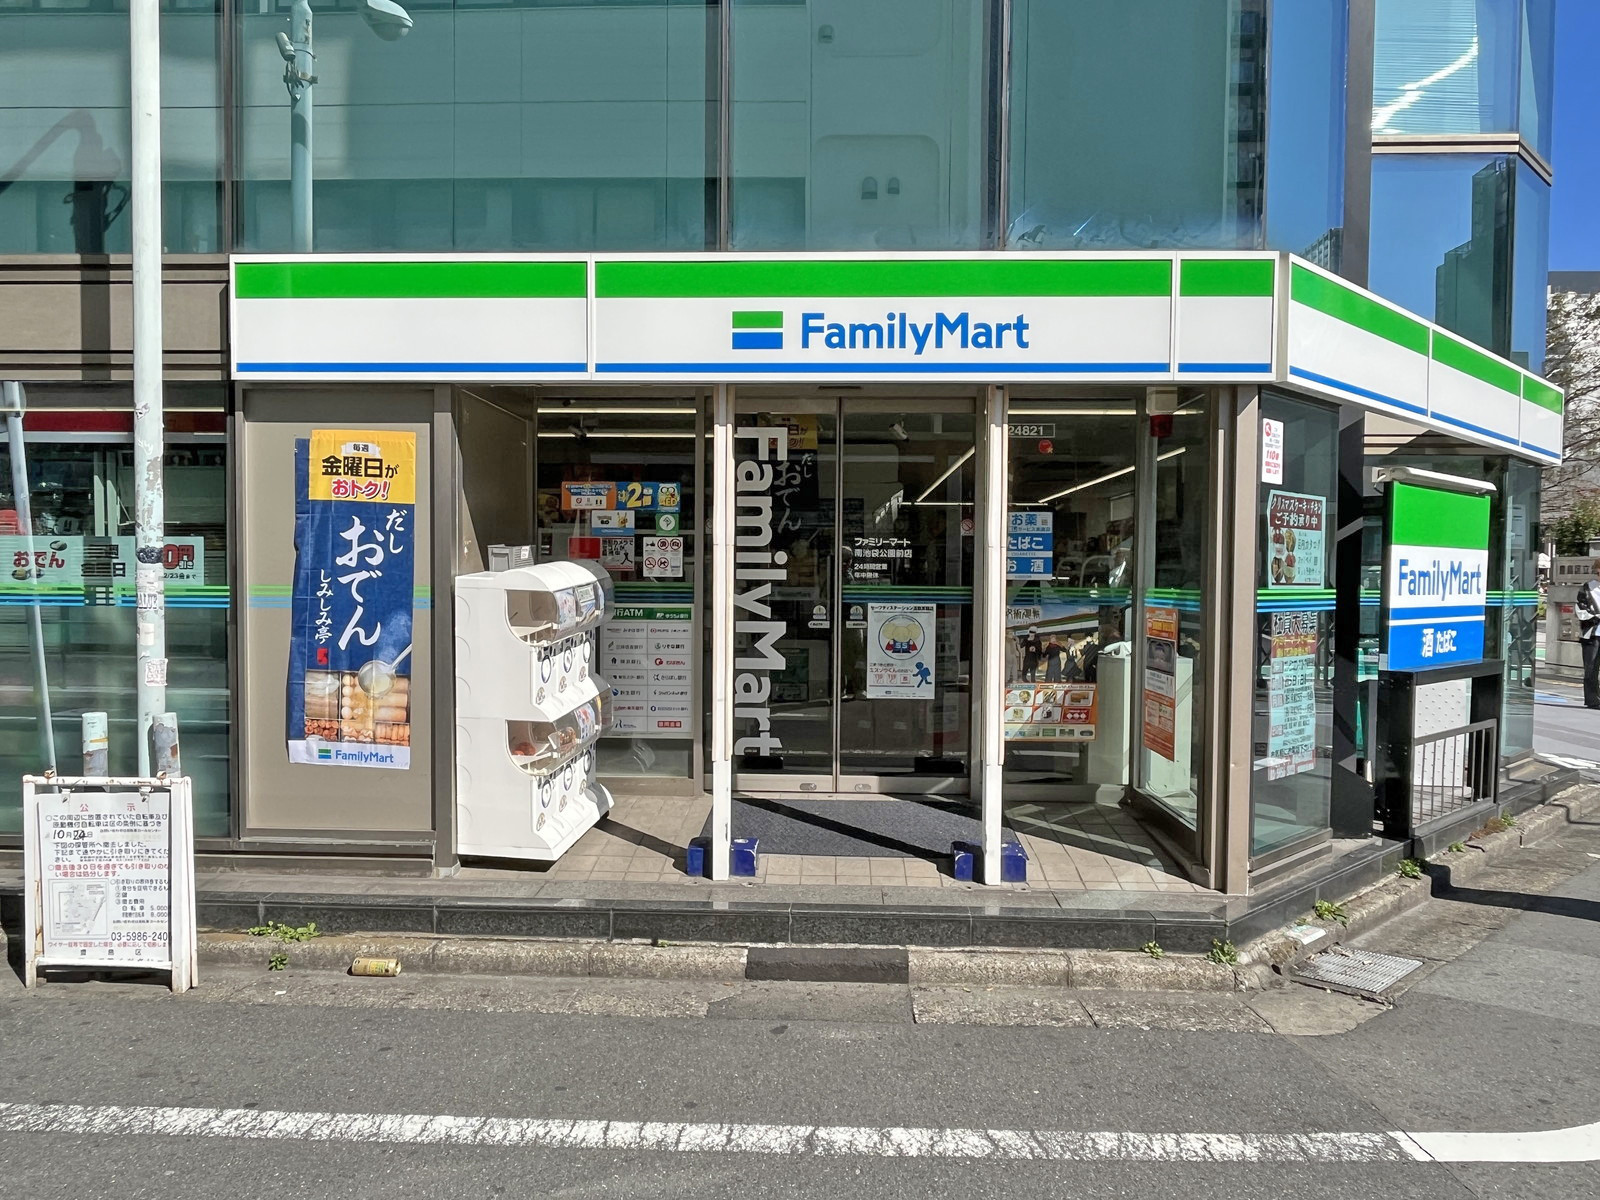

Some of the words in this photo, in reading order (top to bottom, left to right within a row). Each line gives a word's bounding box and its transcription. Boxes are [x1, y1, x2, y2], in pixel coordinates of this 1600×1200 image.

[802, 312, 1029, 355] FamilyMart
[1008, 425, 1044, 436] 24821
[322, 455, 400, 479] 金曜日が
[1271, 495, 1322, 514] クリスマスケーキ・チキン
[1275, 512, 1318, 528] ご予約承り中
[386, 508, 408, 554] だし
[854, 537, 911, 547] ファミリーマート
[1008, 536, 1044, 550] たばこ
[13, 550, 65, 568] おでん
[854, 549, 913, 558] 南池袋公園前店
[335, 516, 385, 650] おでん
[1398, 558, 1482, 601] FamilyMart
[734, 427, 788, 757] FamilyMart
[315, 569, 334, 645] しみしみ亭
[1421, 628, 1435, 657] 酒
[1436, 629, 1457, 653] たばこ
[335, 749, 394, 764] FamilyMart
[80, 804, 88, 812] 公
[127, 803, 136, 812] 示
[111, 931, 168, 941] 03-5986-240
